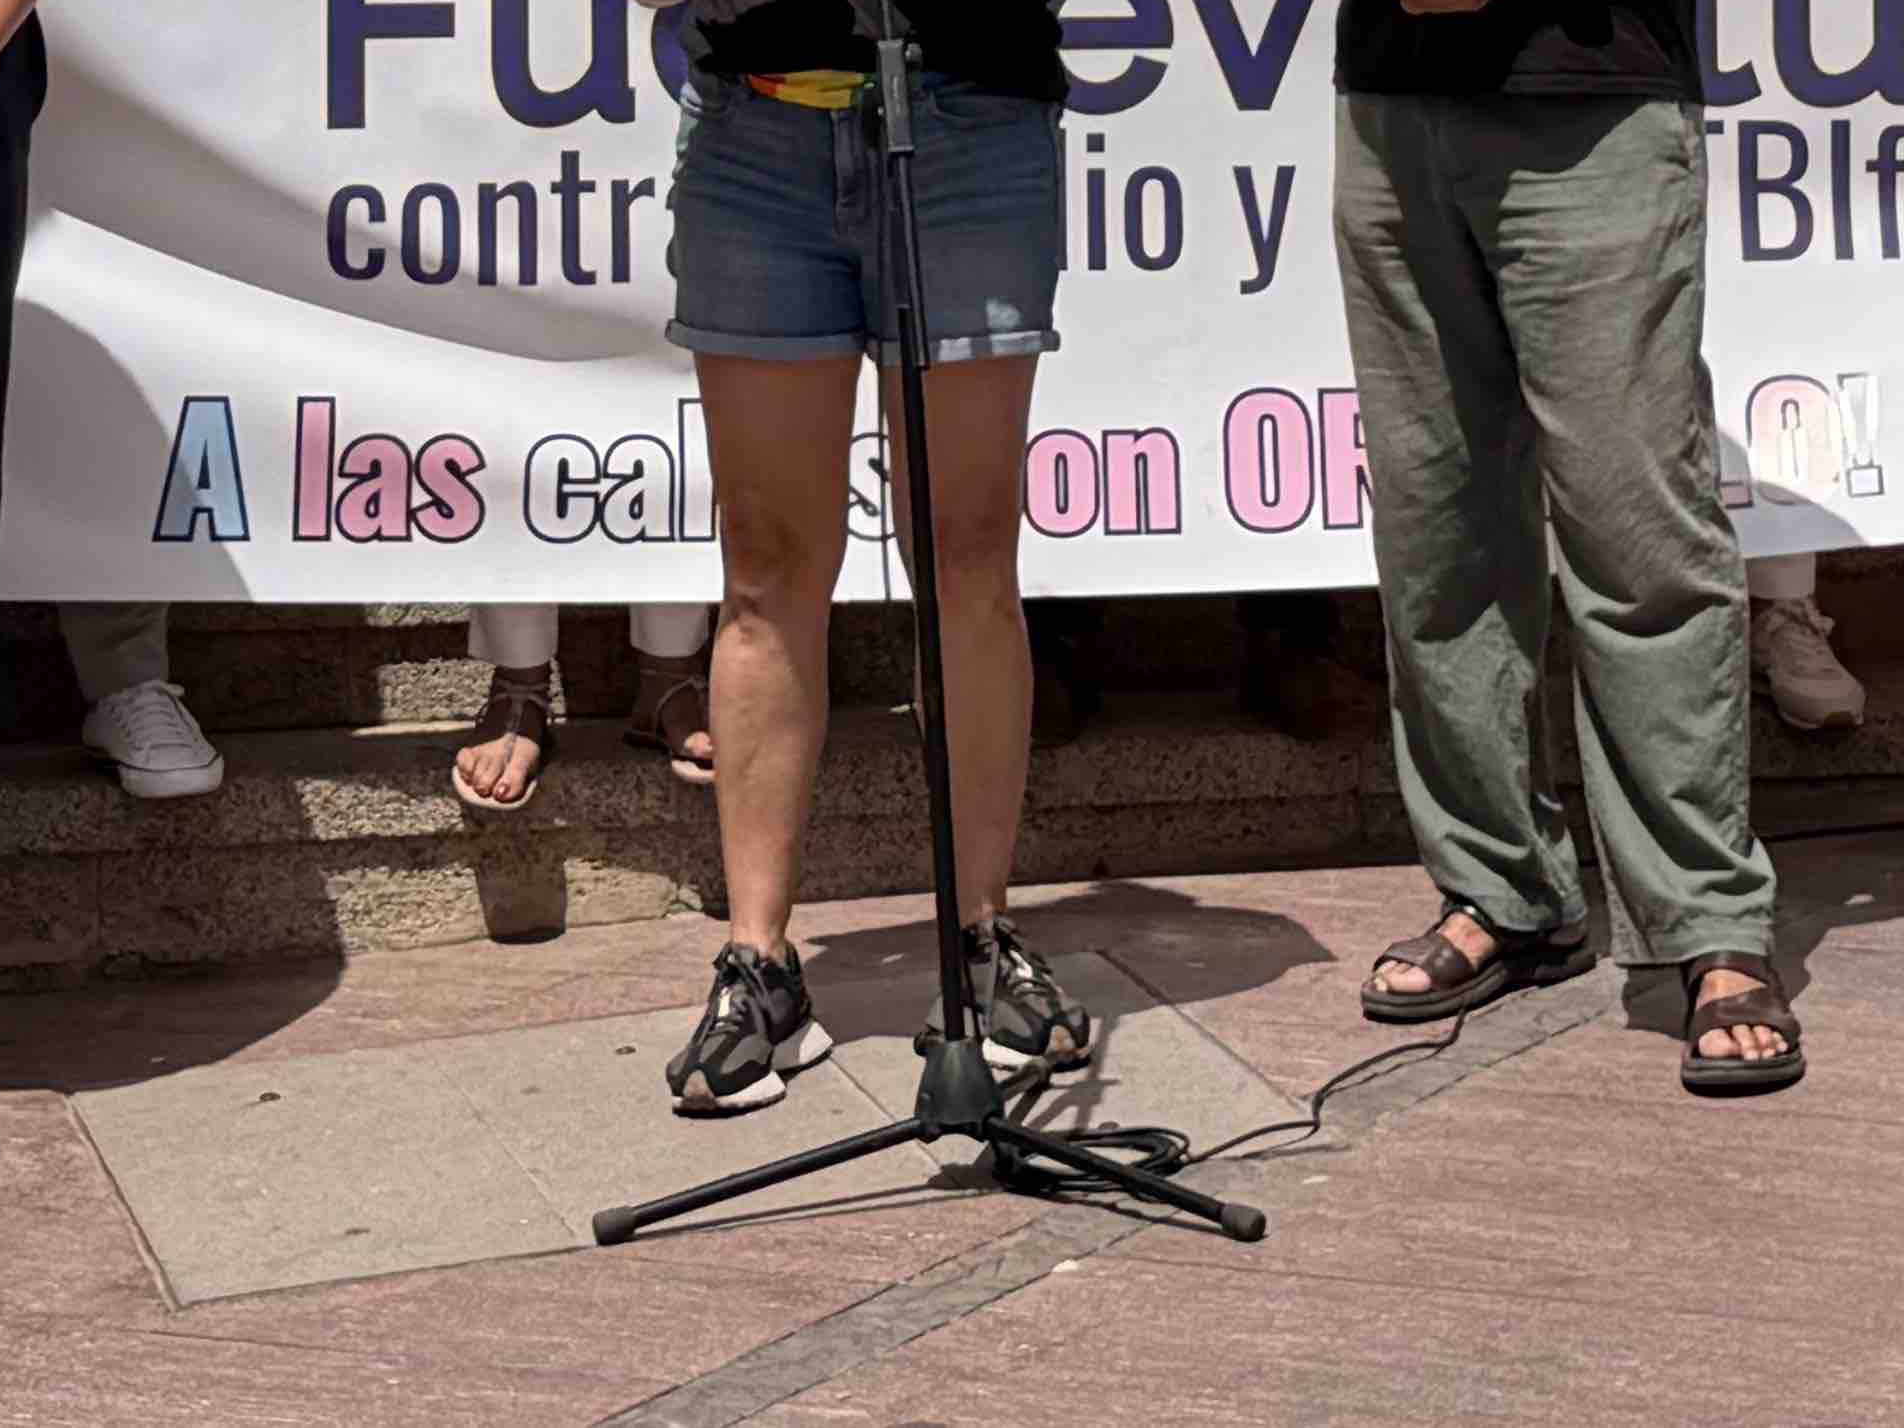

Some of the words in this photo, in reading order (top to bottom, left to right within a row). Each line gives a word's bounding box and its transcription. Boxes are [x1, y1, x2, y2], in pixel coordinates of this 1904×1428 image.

[326, 150, 684, 286] contr
[1232, 165, 1297, 296] y
[153, 395, 250, 544] A
[293, 395, 487, 544] las
[1025, 426, 1184, 538] on
